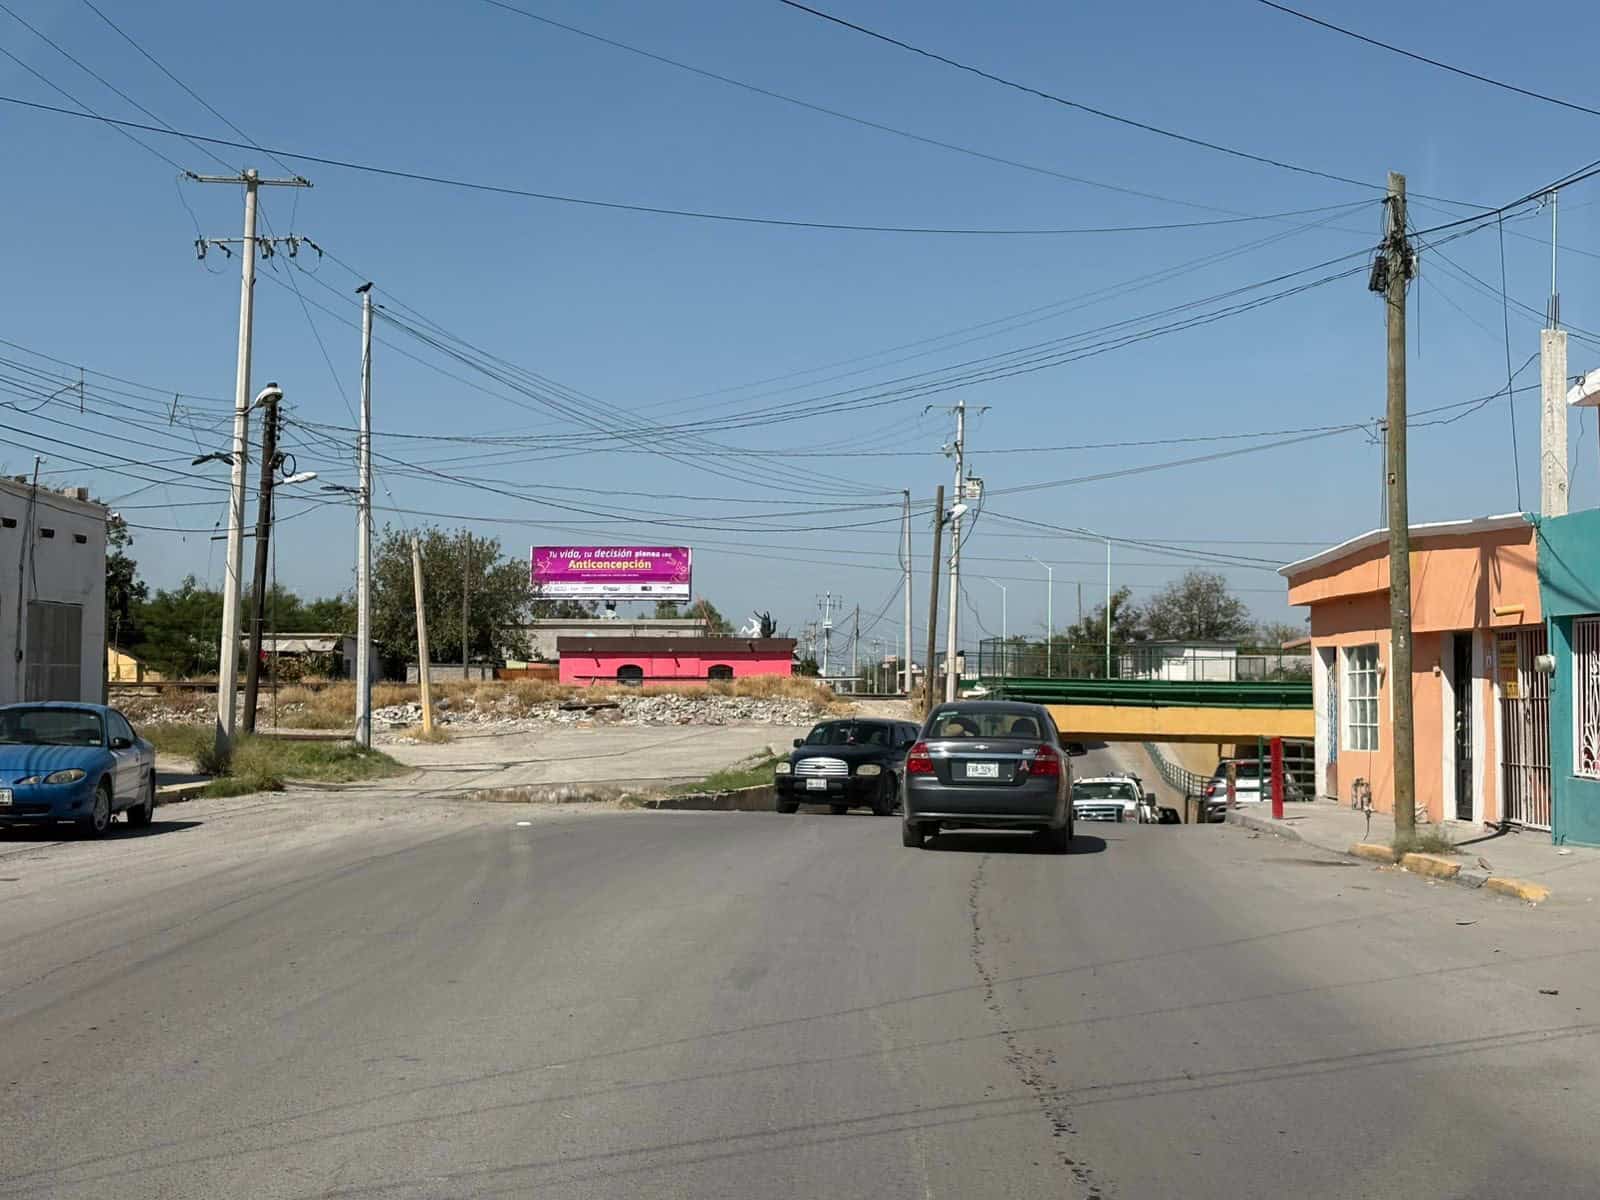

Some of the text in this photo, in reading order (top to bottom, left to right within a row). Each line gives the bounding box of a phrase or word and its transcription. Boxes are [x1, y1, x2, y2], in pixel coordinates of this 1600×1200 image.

[560, 549, 582, 559] vida,
[594, 548, 632, 558] decisión
[568, 559, 652, 570] Anticoncepción
